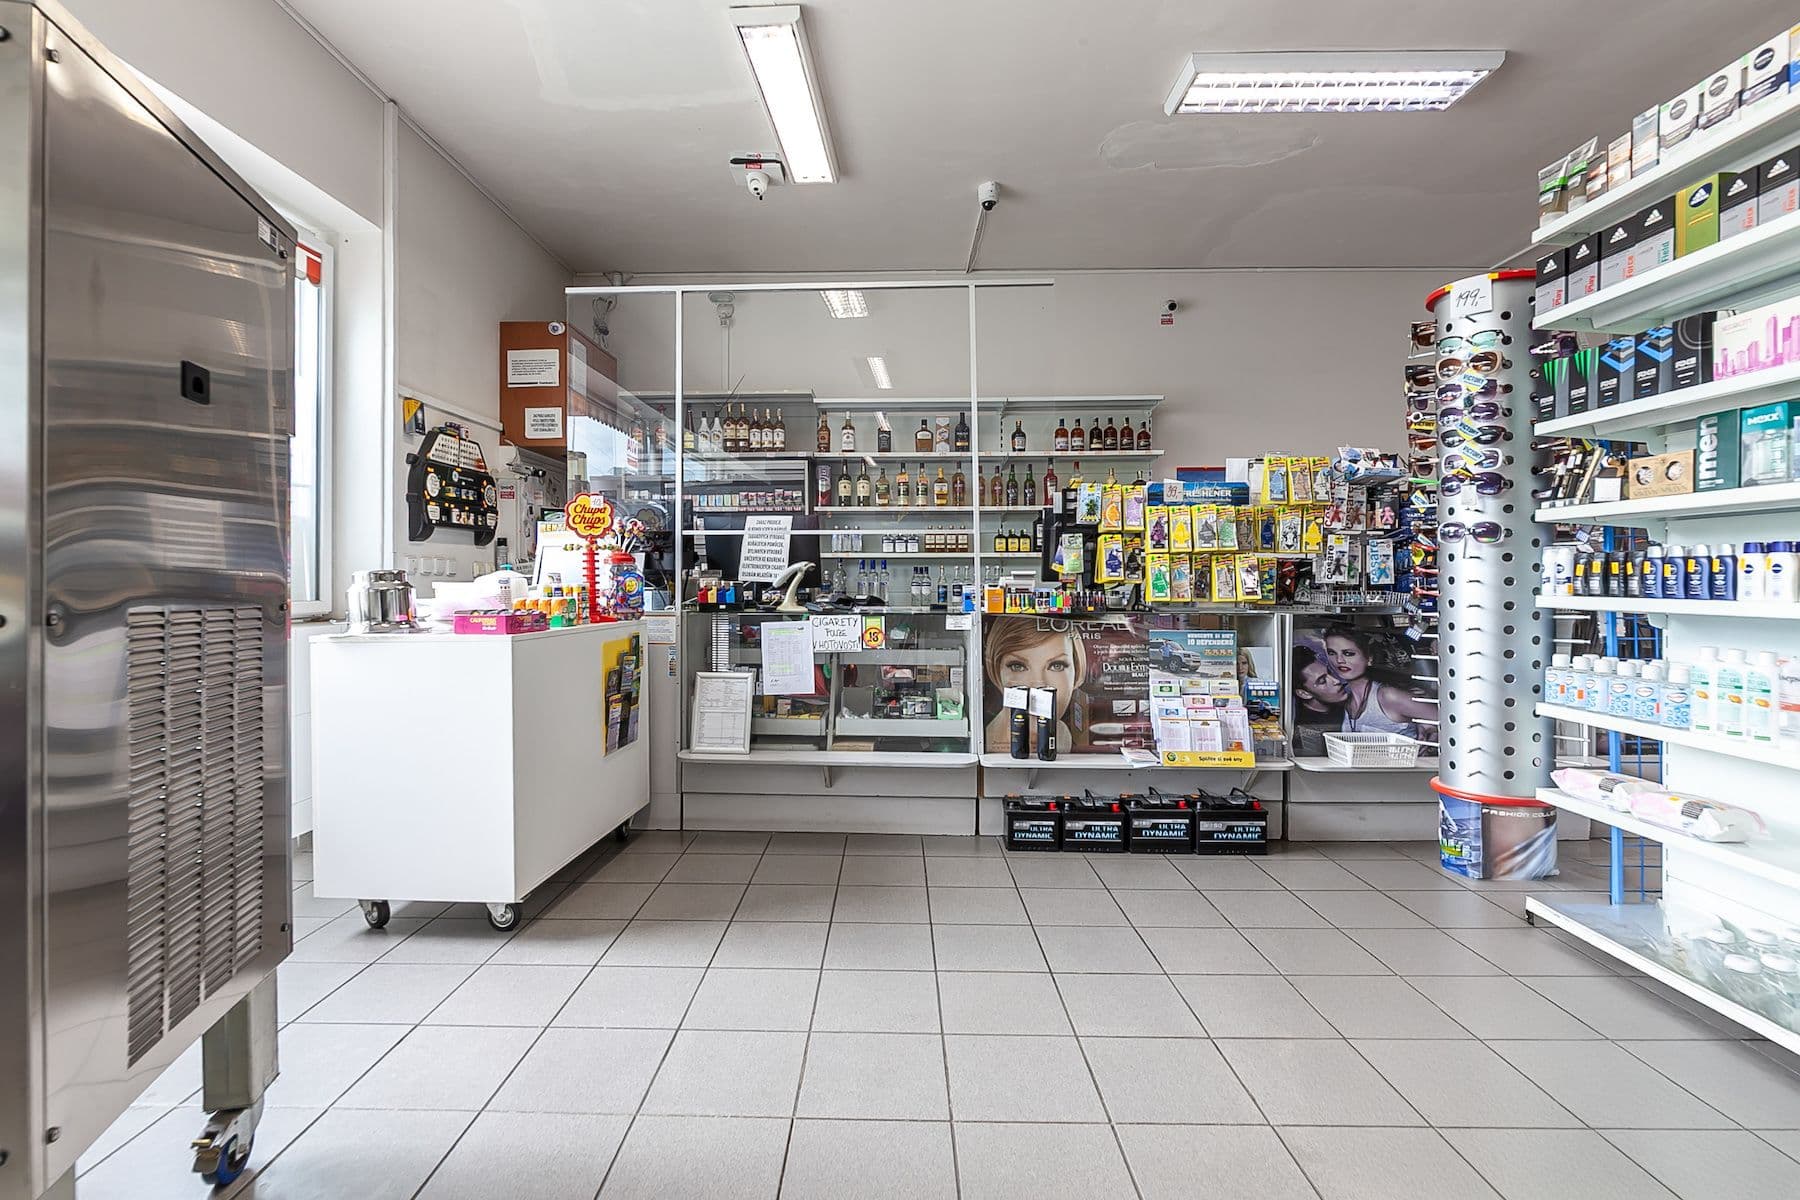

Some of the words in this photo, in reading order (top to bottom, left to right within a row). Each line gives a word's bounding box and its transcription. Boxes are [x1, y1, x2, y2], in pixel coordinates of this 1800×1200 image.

[574, 504, 608, 516] Chupa
[572, 514, 606, 529] Chups
[812, 617, 858, 628] CIGARETY
[1482, 808, 1530, 818] FASHION
